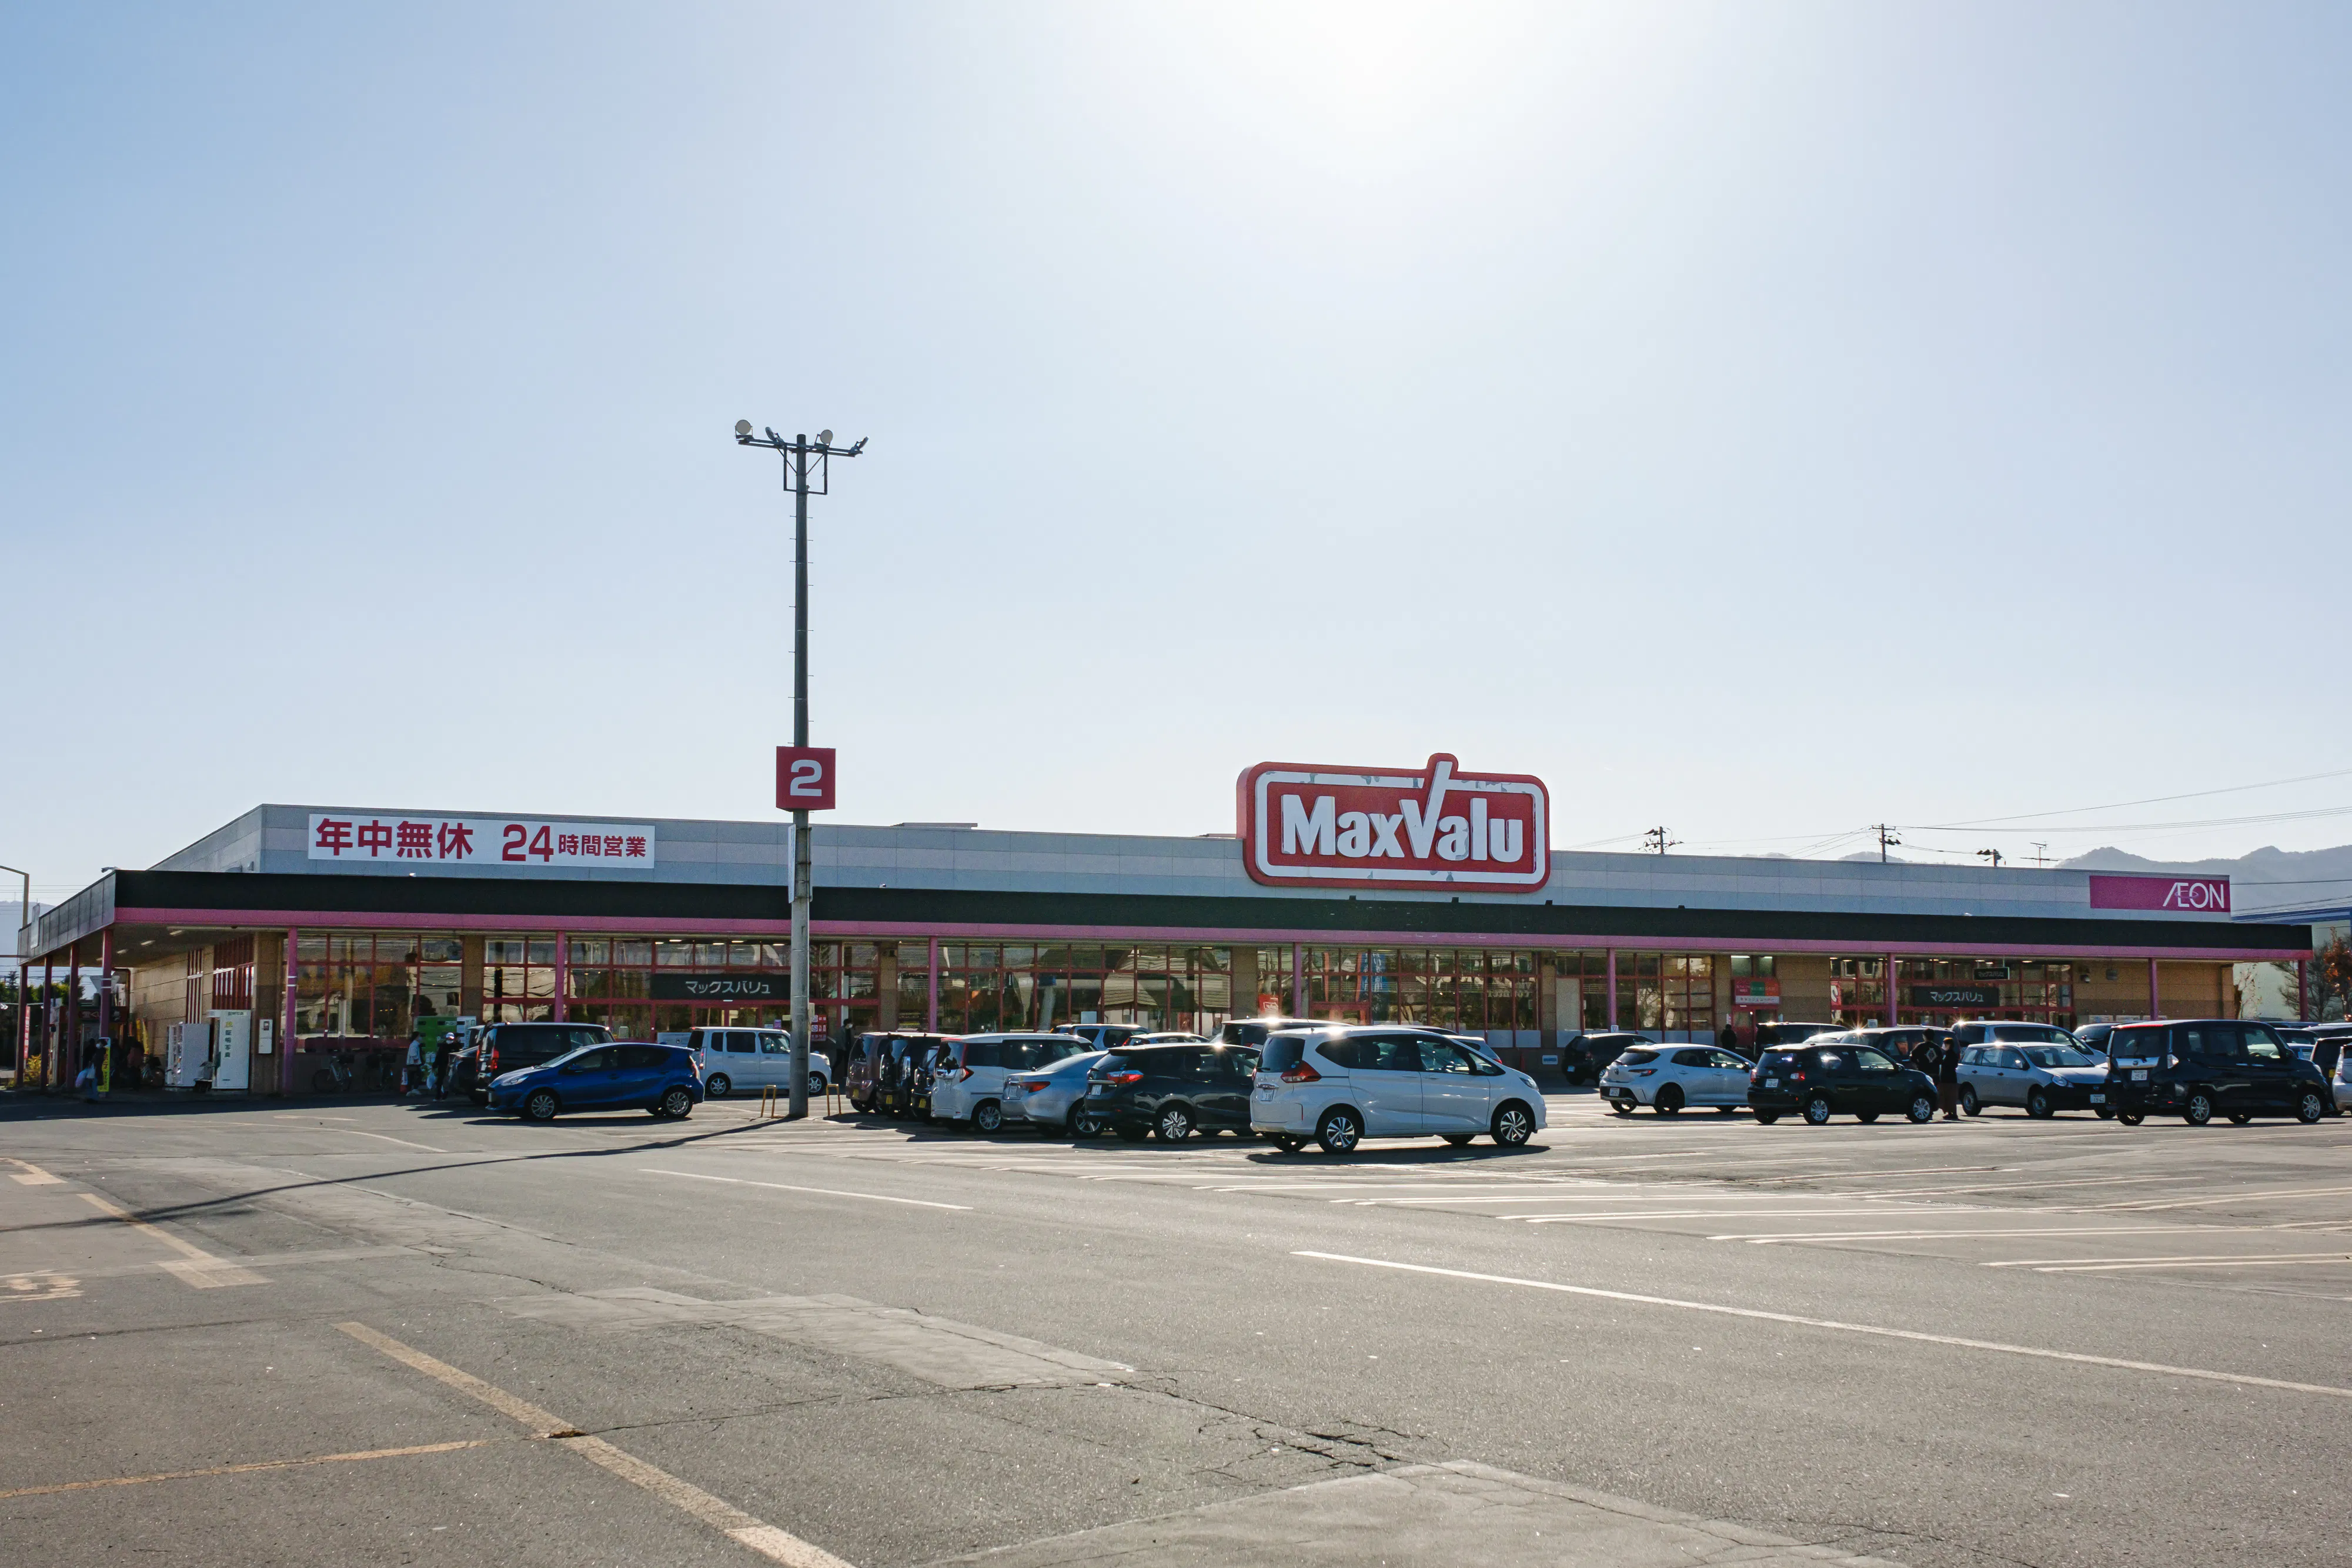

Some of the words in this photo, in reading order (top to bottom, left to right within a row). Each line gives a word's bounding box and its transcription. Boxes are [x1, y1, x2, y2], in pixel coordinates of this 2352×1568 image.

[790, 760, 822, 796] 2
[1281, 761, 1523, 862] MaxValu
[316, 818, 473, 858] 年中無休
[502, 824, 646, 862] 24時間営業
[686, 981, 771, 994] マックスバリュ
[1930, 991, 1984, 1002] マックスバリュ
